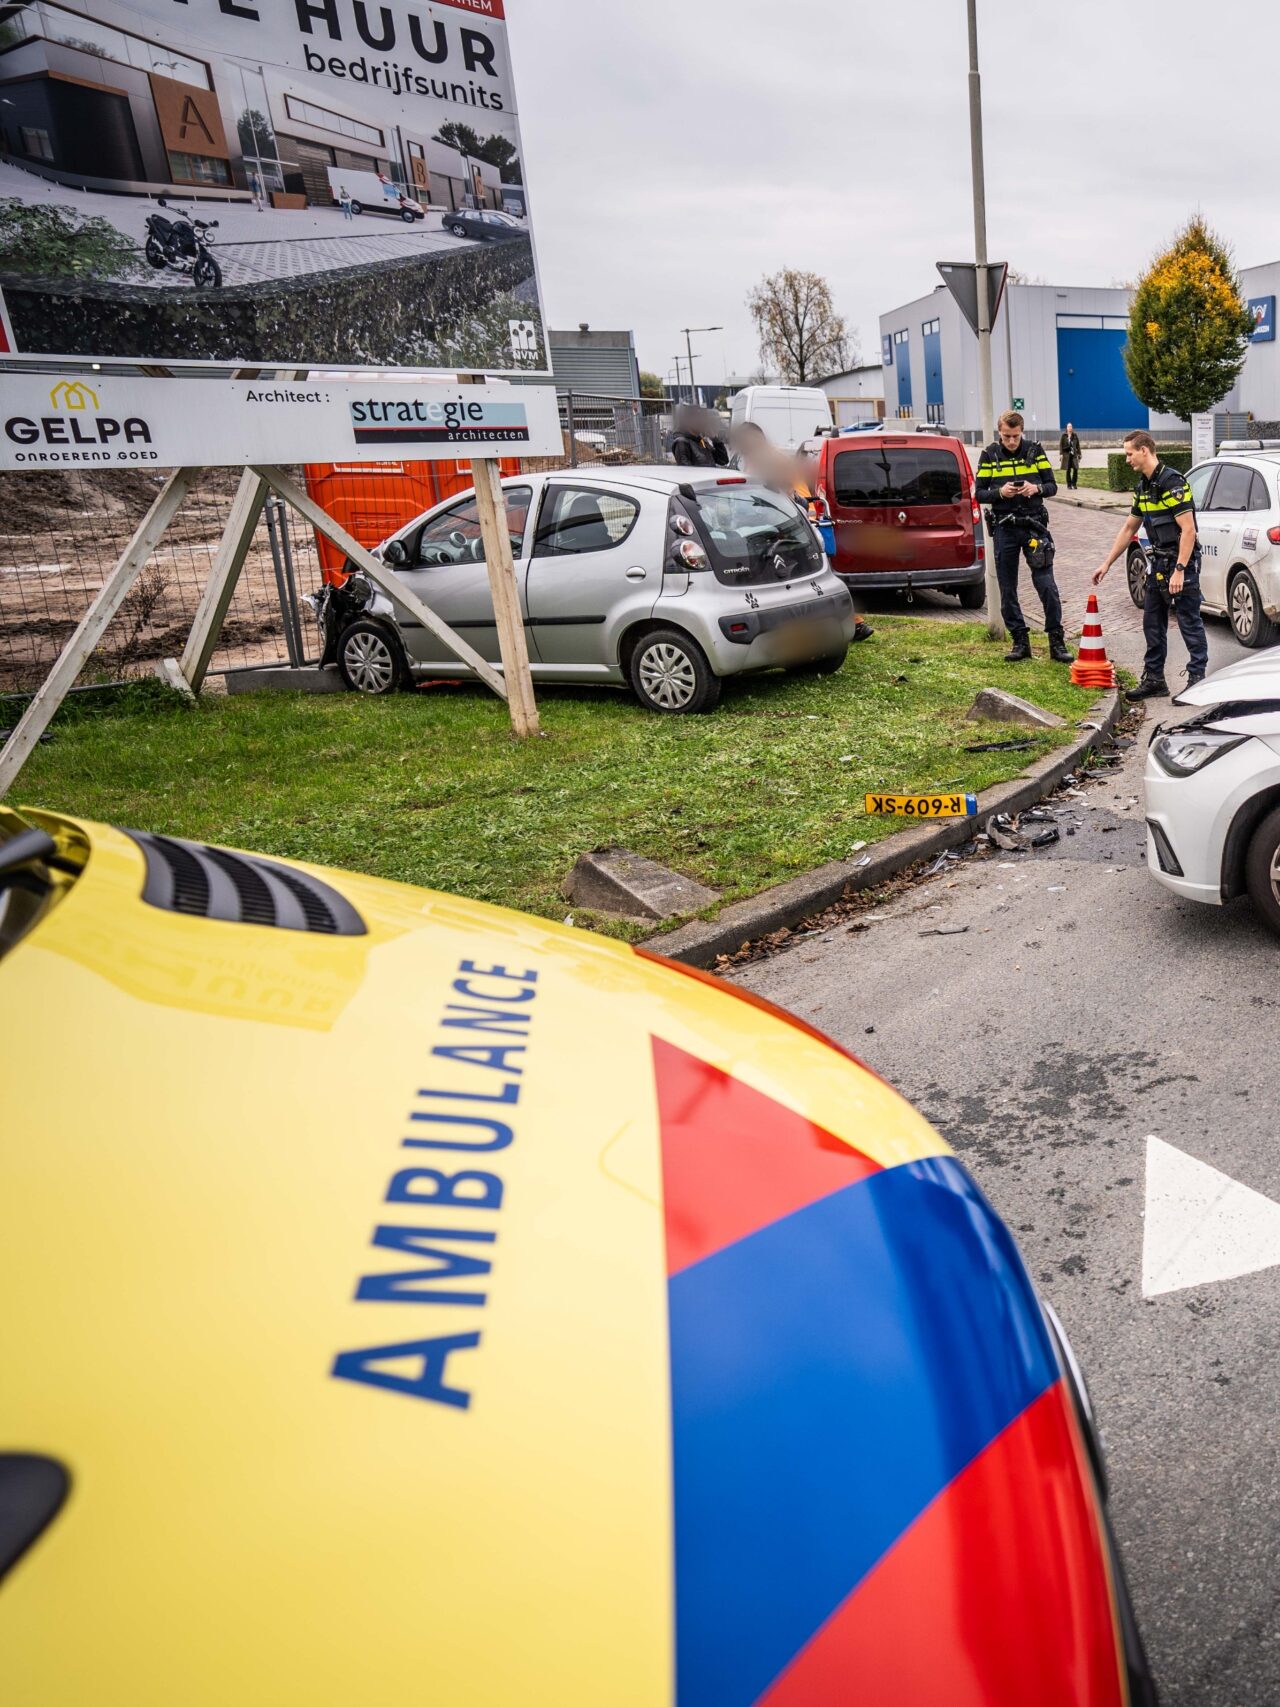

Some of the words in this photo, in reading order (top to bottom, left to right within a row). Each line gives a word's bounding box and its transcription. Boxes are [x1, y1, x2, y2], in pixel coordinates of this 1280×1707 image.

[294, 0, 498, 77] HUUR
[303, 44, 503, 111] bedrijfsunits
[179, 95, 215, 145] A
[513, 350, 539, 360] NVM
[246, 389, 321, 403] Architect
[352, 395, 484, 429] strategie
[4, 417, 152, 445] GELPA
[447, 430, 524, 441] architecten
[1200, 544, 1218, 557] LITIE
[871, 797, 961, 815] R-609-SK
[330, 959, 538, 1411] AMBULANCE
